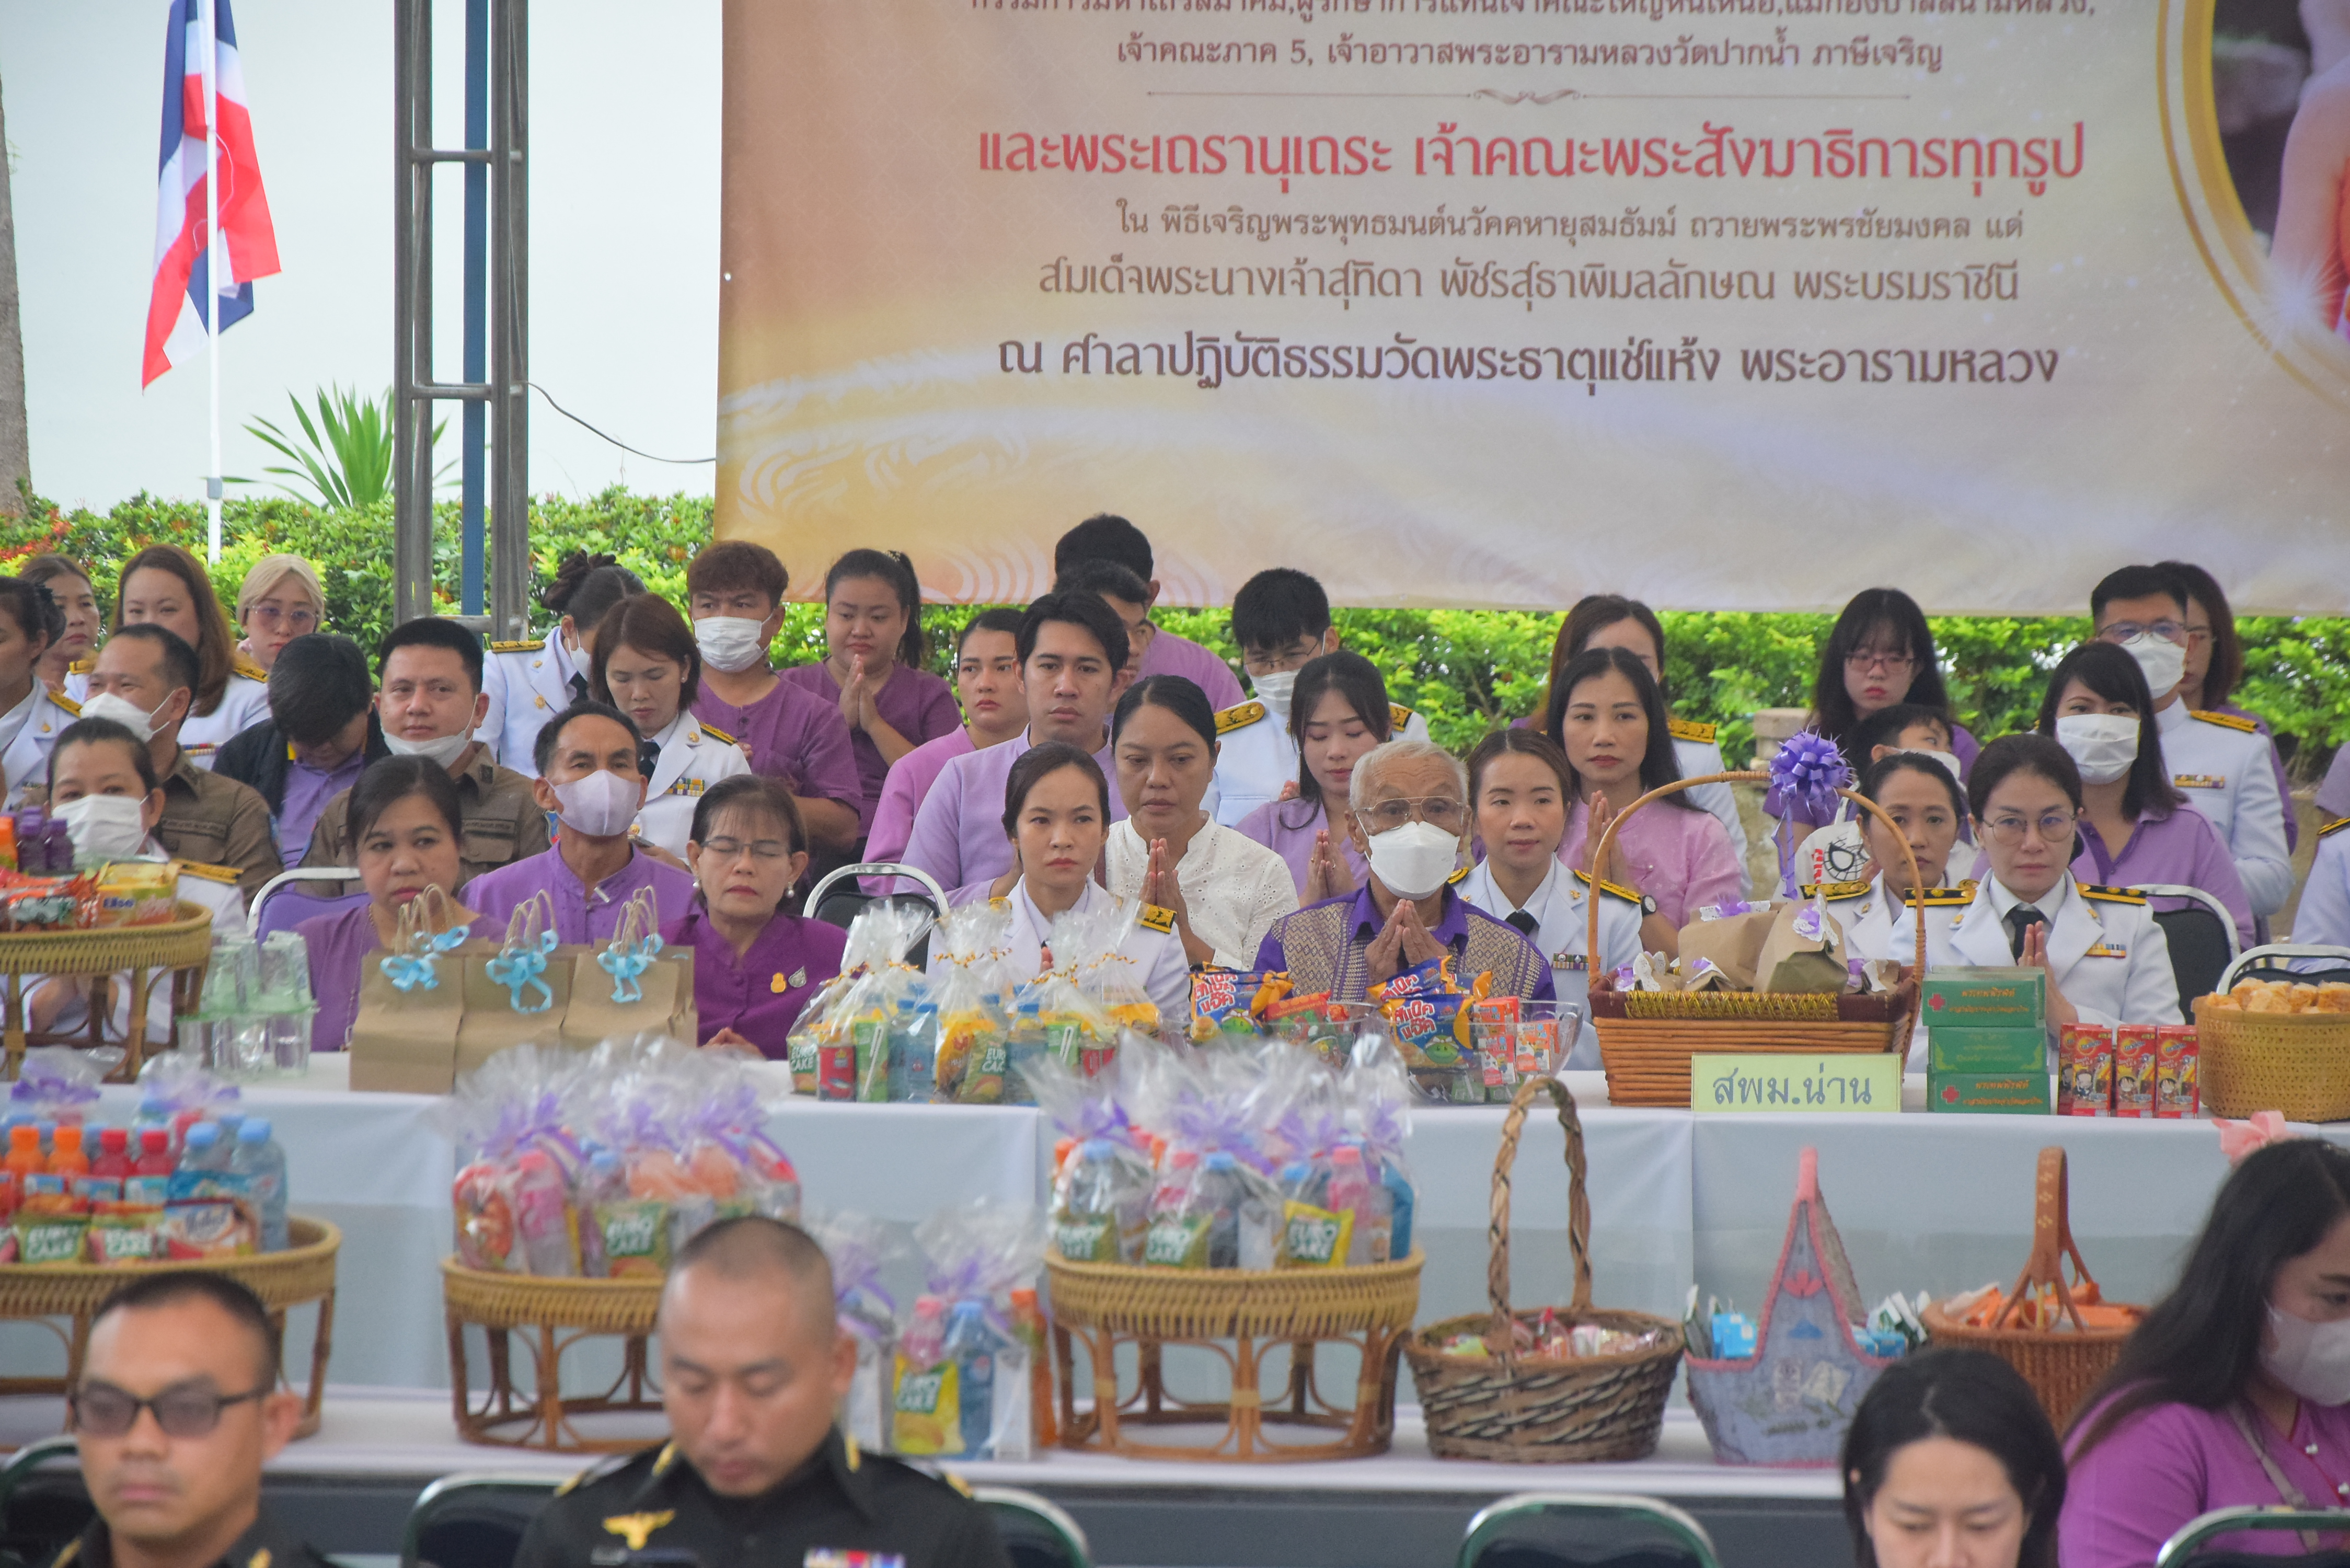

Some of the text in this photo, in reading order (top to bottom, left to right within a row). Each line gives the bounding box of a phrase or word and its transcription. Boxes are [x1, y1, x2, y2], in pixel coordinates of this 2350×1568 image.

[1118, 26, 1942, 74] เจ้าคณะภาค 5, เจ้าอาวาสพระอารามหลวงวัดปากน้ำ ภาษีเจริญ
[979, 121, 2085, 198] และพระเถรานุเถระ เจ้าคณะพระสังฆาธิการทุกรูป
[1115, 198, 2023, 247] ใน พิธีเจริญพระพุทธมนต์นวัคคหายุสมธัมม์ ถวายพระพรชัยมงคล แด่
[1039, 253, 2019, 312] สมเด็จพระนางเจ้าสุทิดา พัชรสุธาพิมลลักษณ พระบรมราชินี
[998, 330, 2059, 397] ณ ศาลาปฏิบัติธรรมวัดพระธาตุแช่แห้ง พระอารามหลวง
[1712, 1062, 1872, 1104] สพม.น่าน
